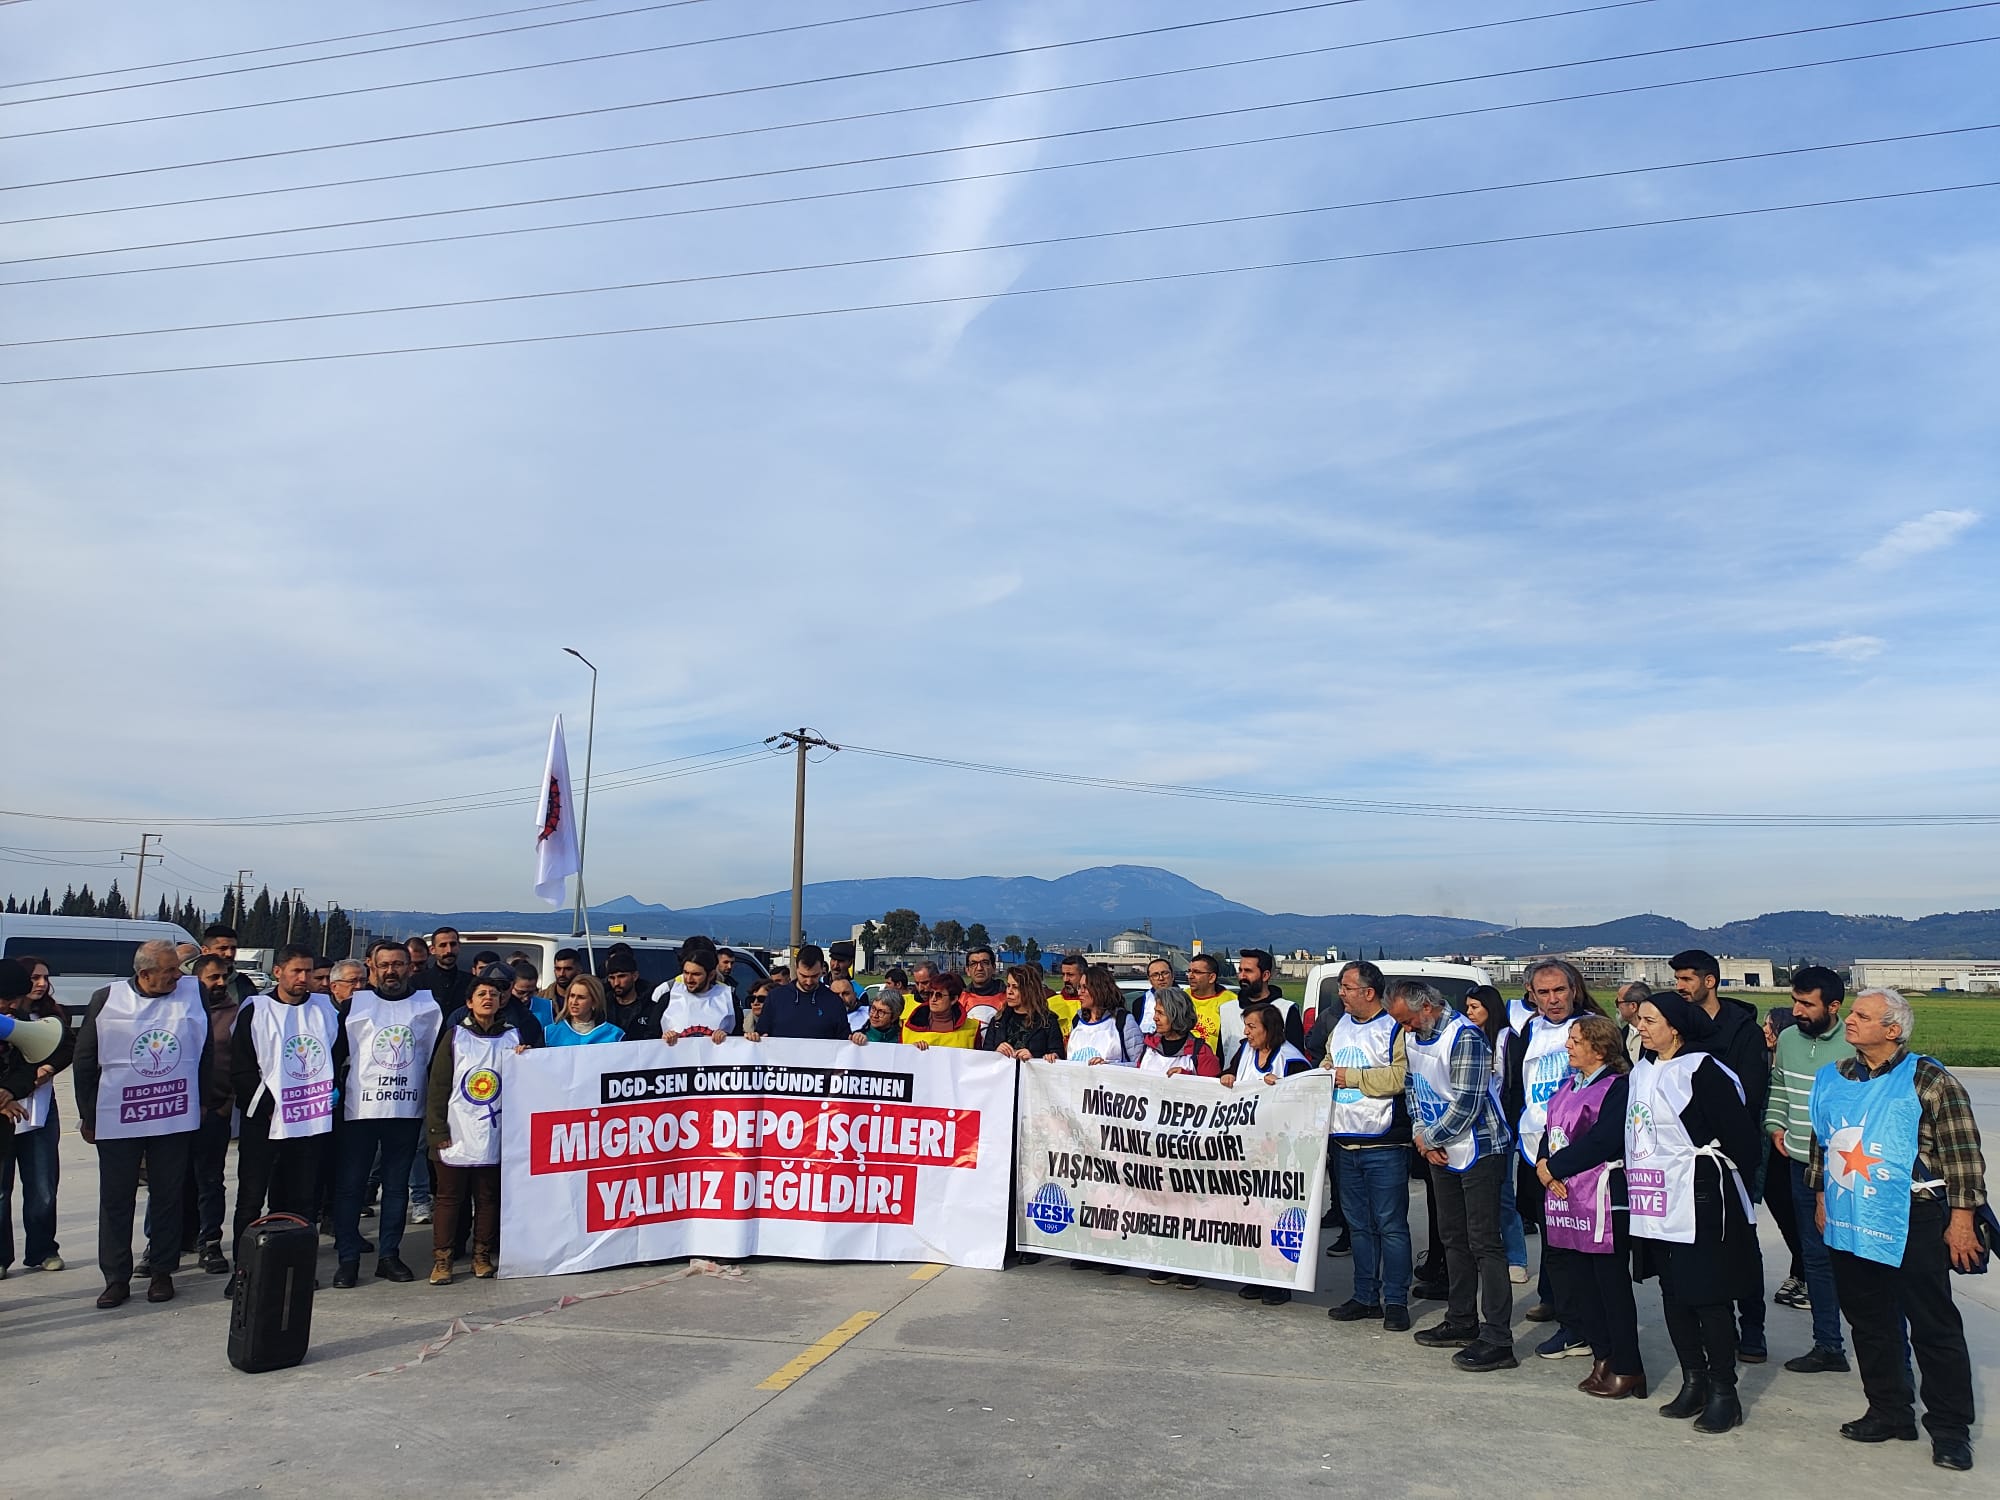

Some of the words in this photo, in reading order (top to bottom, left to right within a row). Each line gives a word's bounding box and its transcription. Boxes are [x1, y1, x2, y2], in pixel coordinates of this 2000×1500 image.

[125, 1090, 133, 1098] JI
[136, 1088, 150, 1097] BO
[153, 1084, 175, 1095] NAN
[289, 1090, 301, 1098] BO
[304, 1084, 324, 1095] NAN
[378, 1074, 408, 1087] İZMİR
[608, 1073, 687, 1099] DGD-SEN
[694, 1066, 824, 1093] ÖNCÜLÜĞÜNDE
[829, 1069, 905, 1098] DİRENEN
[362, 1089, 373, 1101] İL
[376, 1088, 418, 1101] ÖRGÜTÜ
[124, 1095, 185, 1120] AŞTIYÊ
[1082, 1085, 1148, 1121] MİGROS
[1158, 1100, 1208, 1129] DEPO
[550, 1109, 700, 1164] MİGROS
[712, 1110, 804, 1149] DEPO
[816, 1101, 956, 1163] İŞÇİLERİ
[1100, 1124, 1152, 1157] YALNIZ
[1156, 1129, 1246, 1161] DEĞİLDİR!
[1048, 1151, 1120, 1189] YAŞASIN
[1123, 1162, 1164, 1191] SINIF
[1169, 1168, 1305, 1206] DAYANIŞMASI!
[597, 1171, 724, 1221] YALNIZ
[733, 1160, 904, 1216] DEĞİLDİR!
[1630, 1191, 1662, 1212] TIYÊ
[1026, 1202, 1075, 1224] KESK
[1548, 1197, 1569, 1211] İZMİR
[1044, 1223, 1058, 1231] 1995
[1080, 1201, 1119, 1231] İZMİR
[1121, 1211, 1180, 1240] ŞUBELER
[1183, 1217, 1262, 1248] PLATFORMU
